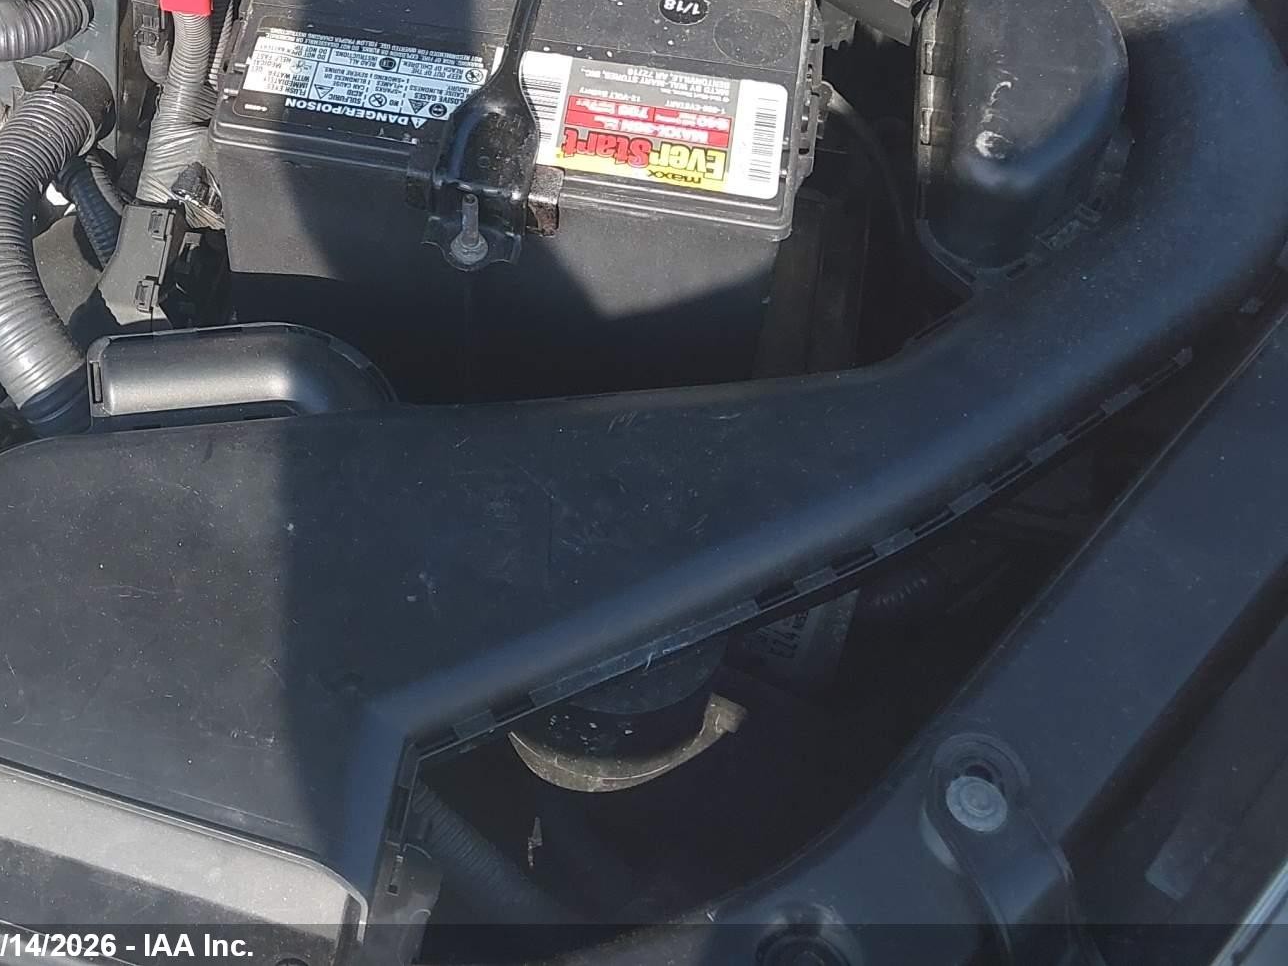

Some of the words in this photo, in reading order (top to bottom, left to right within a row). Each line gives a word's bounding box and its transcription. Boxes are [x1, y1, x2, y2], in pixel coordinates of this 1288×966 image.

[253, 58, 281, 67] MEDICAL
[275, 55, 291, 63] HELP
[345, 69, 368, 77] SEVERE
[442, 66, 462, 74] REACH
[262, 76, 308, 88] IMMEDIATELY
[334, 75, 366, 83] BLINDNESS
[332, 80, 351, 88] CAUSE
[284, 86, 306, 94] FLUSH
[408, 84, 443, 94] BLINDNESS
[328, 93, 361, 104] SULFURIC
[413, 92, 436, 101] GASES
[610, 90, 640, 101] 12-VOLT
[438, 96, 463, 105] LOSIVE
[284, 97, 409, 125] DANGER/POISON
[560, 125, 727, 182] EverStart
[647, 169, 701, 184] maxx
